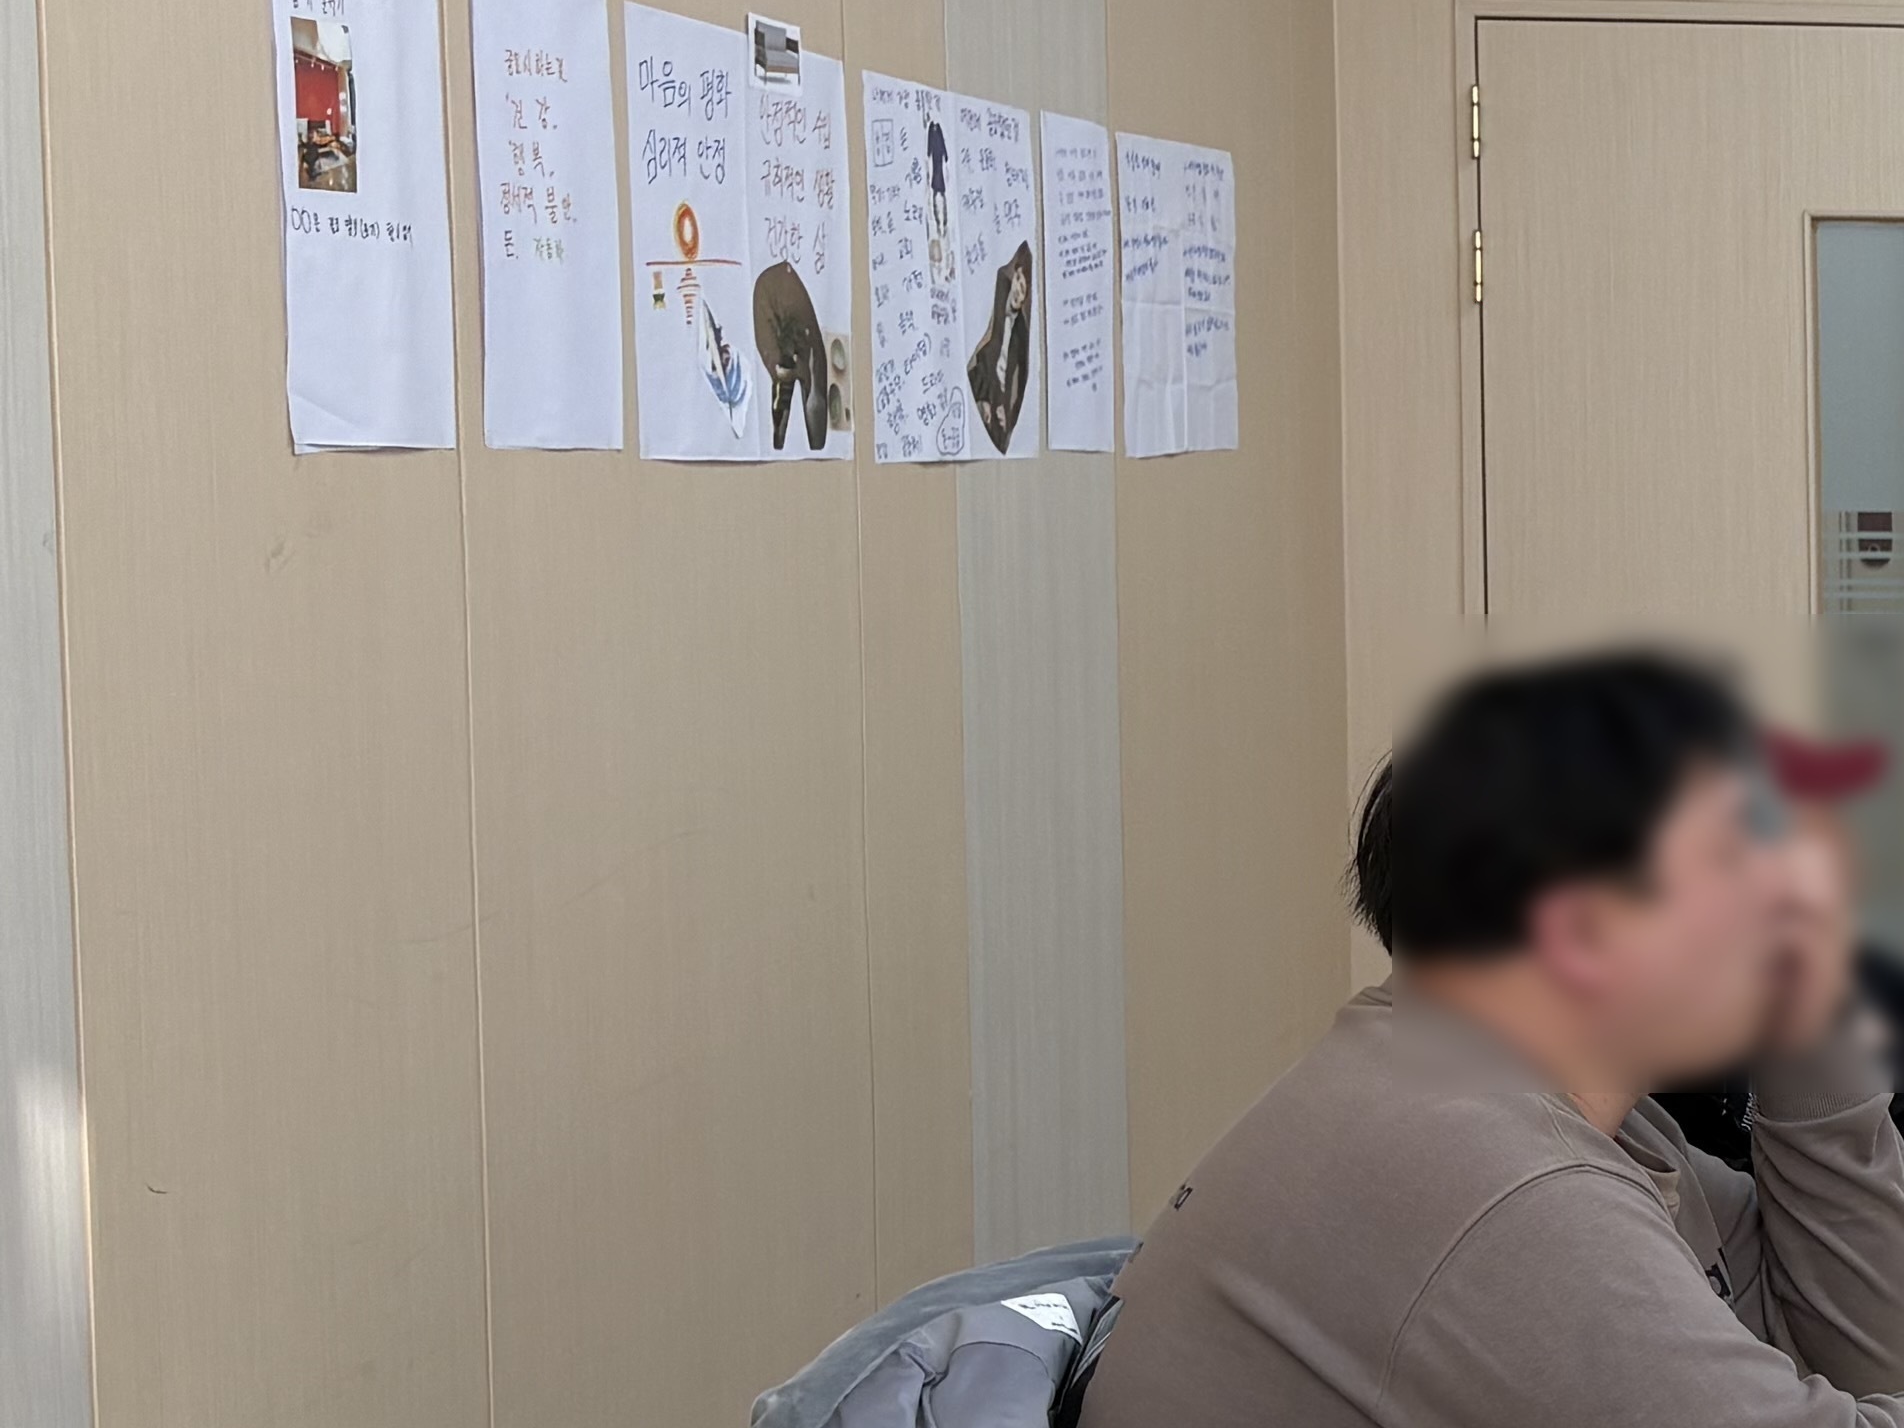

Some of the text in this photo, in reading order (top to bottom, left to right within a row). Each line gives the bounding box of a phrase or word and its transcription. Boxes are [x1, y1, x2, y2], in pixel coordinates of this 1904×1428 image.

[639, 56, 731, 121] 마음의 평화
[760, 95, 806, 147] 안정적인
[641, 129, 727, 184] 심리적 안정
[764, 215, 804, 264] 건강한
